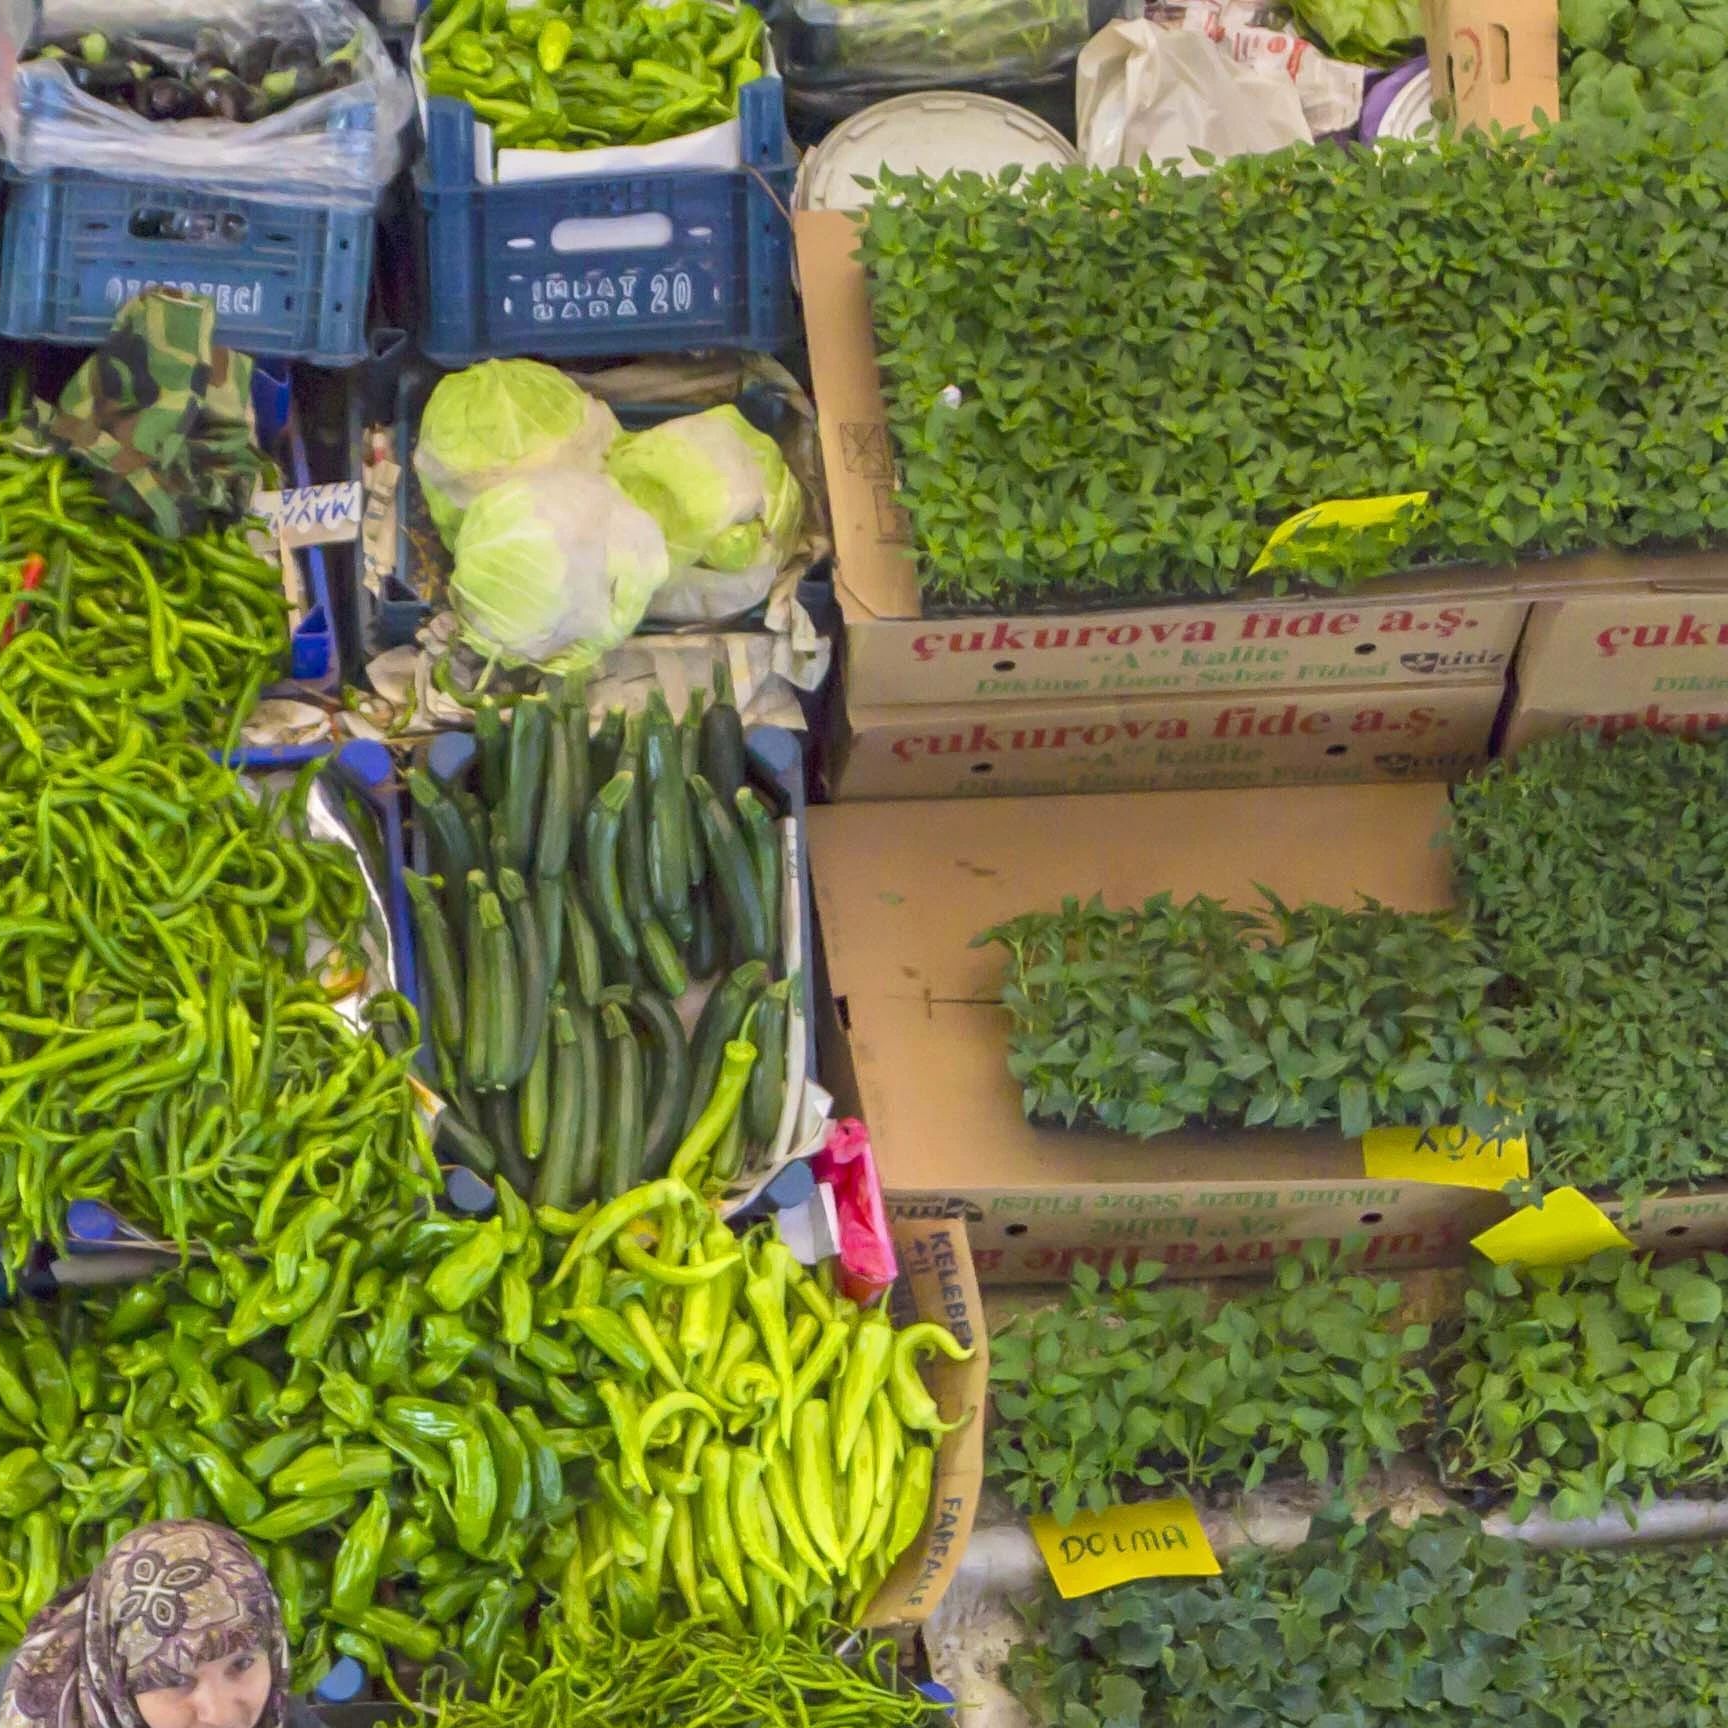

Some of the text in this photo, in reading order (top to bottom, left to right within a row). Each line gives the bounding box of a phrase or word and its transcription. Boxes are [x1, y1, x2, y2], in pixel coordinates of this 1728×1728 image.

[649, 271, 692, 314] 20
[911, 619, 1217, 662] çukurova
[1240, 611, 1361, 640] fide
[892, 718, 1189, 763] çukurova
[1212, 704, 1331, 738] fide
[1059, 1524, 1189, 1565] DOLMA
